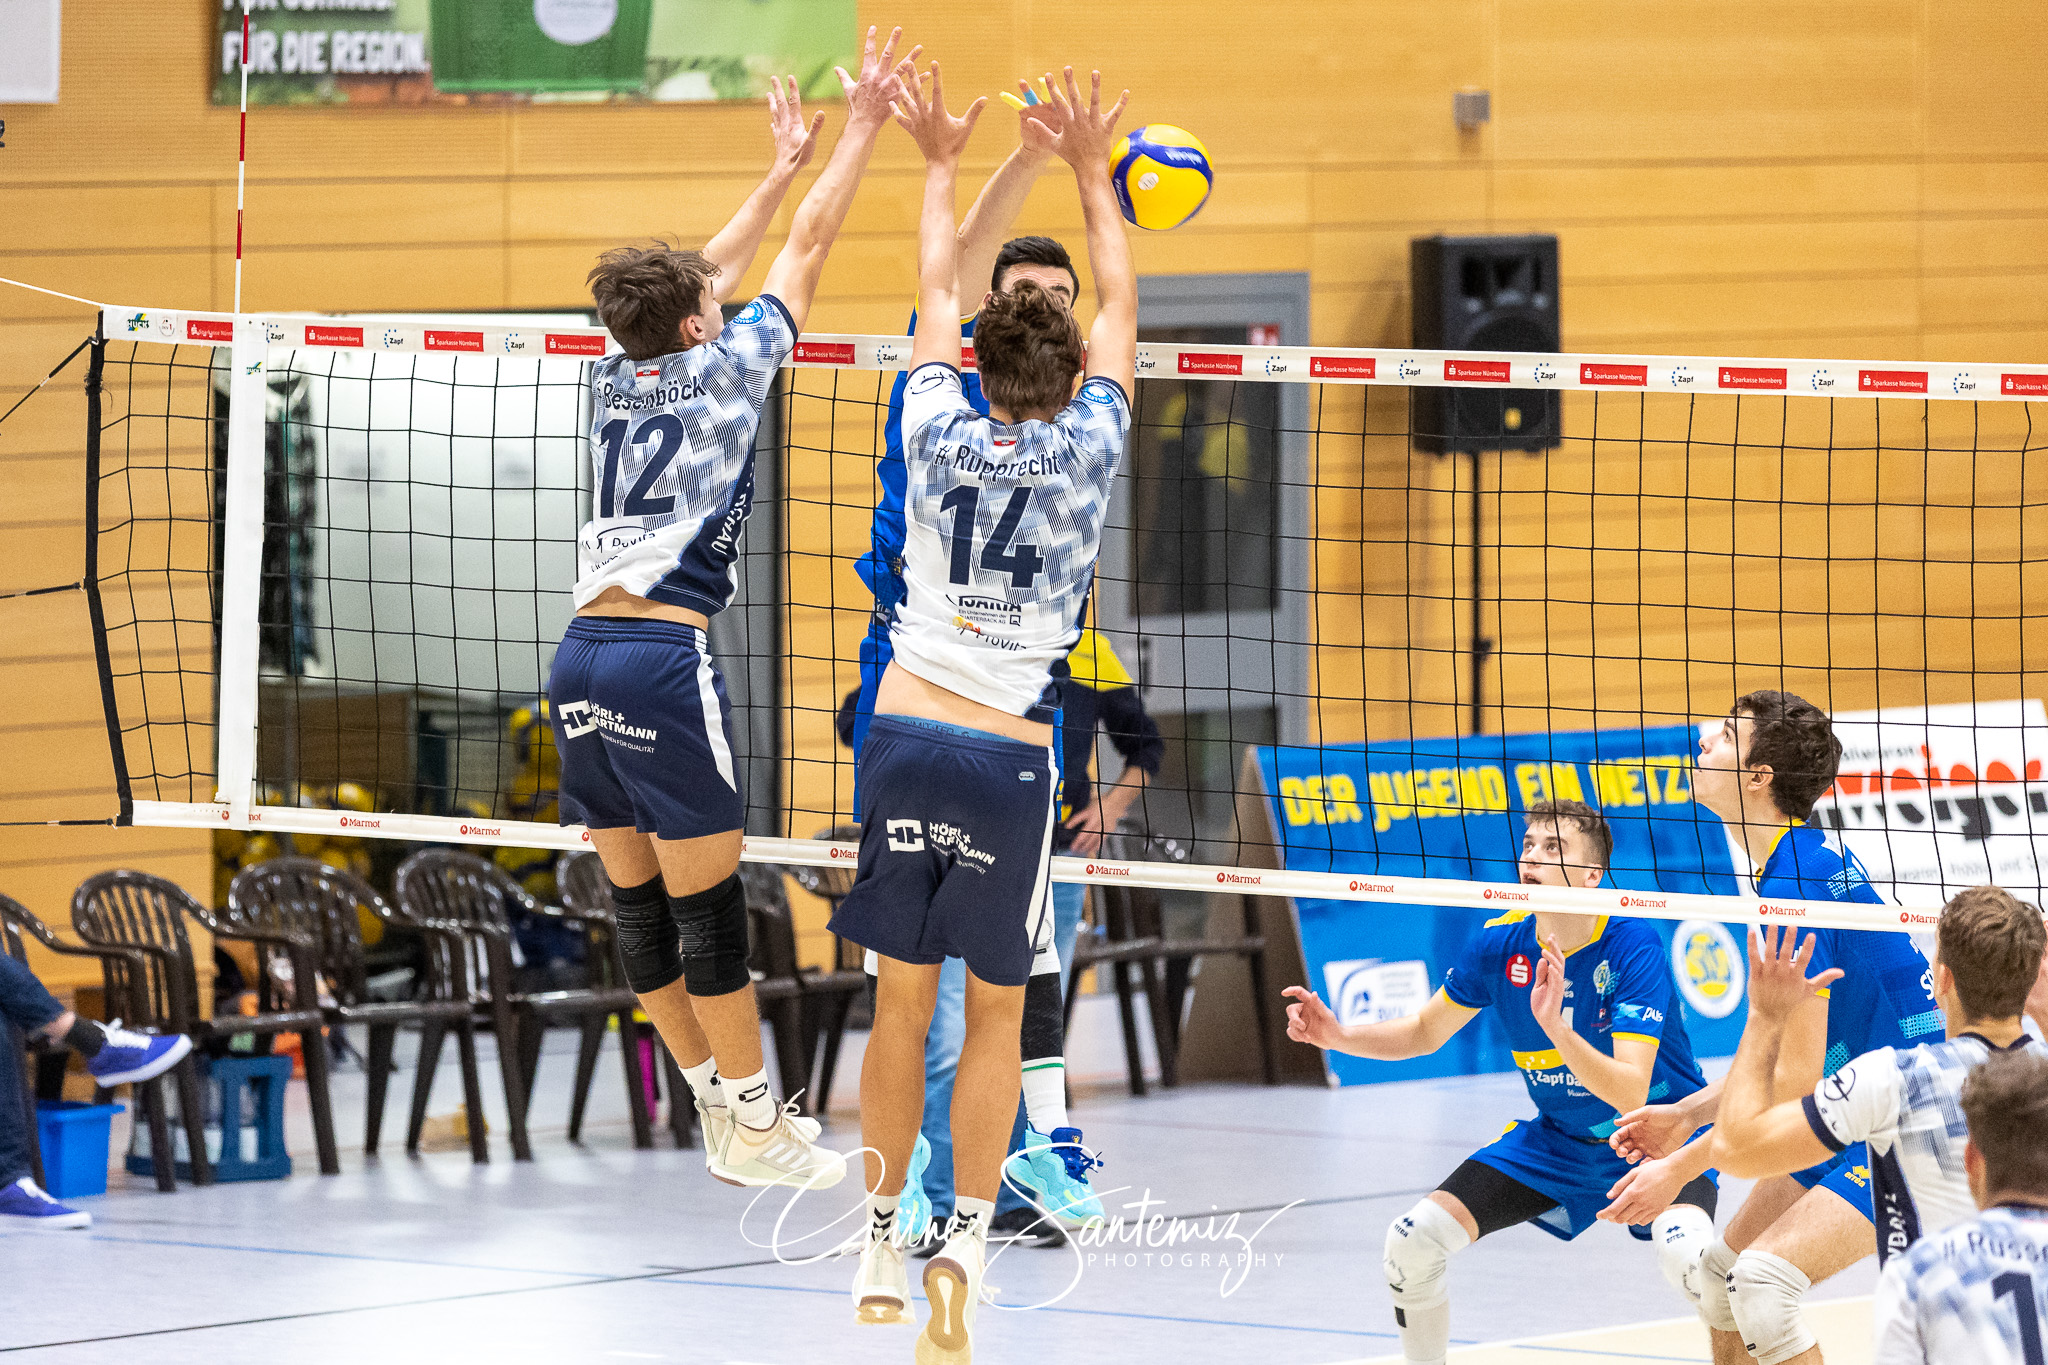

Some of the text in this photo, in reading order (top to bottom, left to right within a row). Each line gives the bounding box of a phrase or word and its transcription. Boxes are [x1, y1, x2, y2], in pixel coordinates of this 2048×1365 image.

[281, 31, 327, 73] DIE
[270, 333, 284, 341] Zapf
[317, 334, 360, 343] Sparkasse Nürnberg
[389, 337, 404, 345] Zapf
[436, 339, 480, 348] Sparkasse Nürnberg
[510, 342, 525, 350] Zapf
[557, 343, 602, 352] Sparkasse Nürnberg
[805, 350, 850, 359] Sparkasse Nürnberg
[1140, 361, 1155, 369] Zapf
[1191, 362, 1238, 371] Sparkasse Nürnberg
[1271, 364, 1287, 373] Zapf
[1323, 366, 1371, 375] Sparkasse Nürnberg
[1405, 368, 1421, 376] Zapf
[1457, 370, 1505, 379] Sparkasse Nürnberg
[1540, 372, 1556, 380] Zapf
[1593, 373, 1643, 382] Sparkasse Nürnberg
[1678, 375, 1694, 384] Zapf
[1732, 376, 1782, 385] Sparkasse Nürnberg
[1818, 378, 1834, 387] Zapf
[1872, 379, 1923, 389] Sparkasse Nürnberg
[1960, 382, 1976, 390] Zapf
[2015, 383, 2040, 391] Sparkasse
[600, 413, 685, 518] 12
[954, 444, 1060, 482] Rupprecht
[940, 484, 1044, 589] 14
[593, 714, 657, 741] ARTMANN
[1279, 773, 1363, 827] DER
[1369, 765, 1508, 832] JUGEND
[1515, 760, 1583, 810] EIN
[349, 818, 380, 828] Marmot
[469, 826, 501, 836] Marmot
[1095, 865, 1130, 876] Marmot
[1226, 873, 1261, 884] Marmot
[1359, 882, 1395, 893] Marmot
[1494, 890, 1529, 901] Marmot
[1630, 897, 1667, 909] Marmot
[1769, 905, 1806, 917] Marmot
[1536, 1070, 1564, 1086] Zapf
[1844, 1171, 1866, 1188] errea
